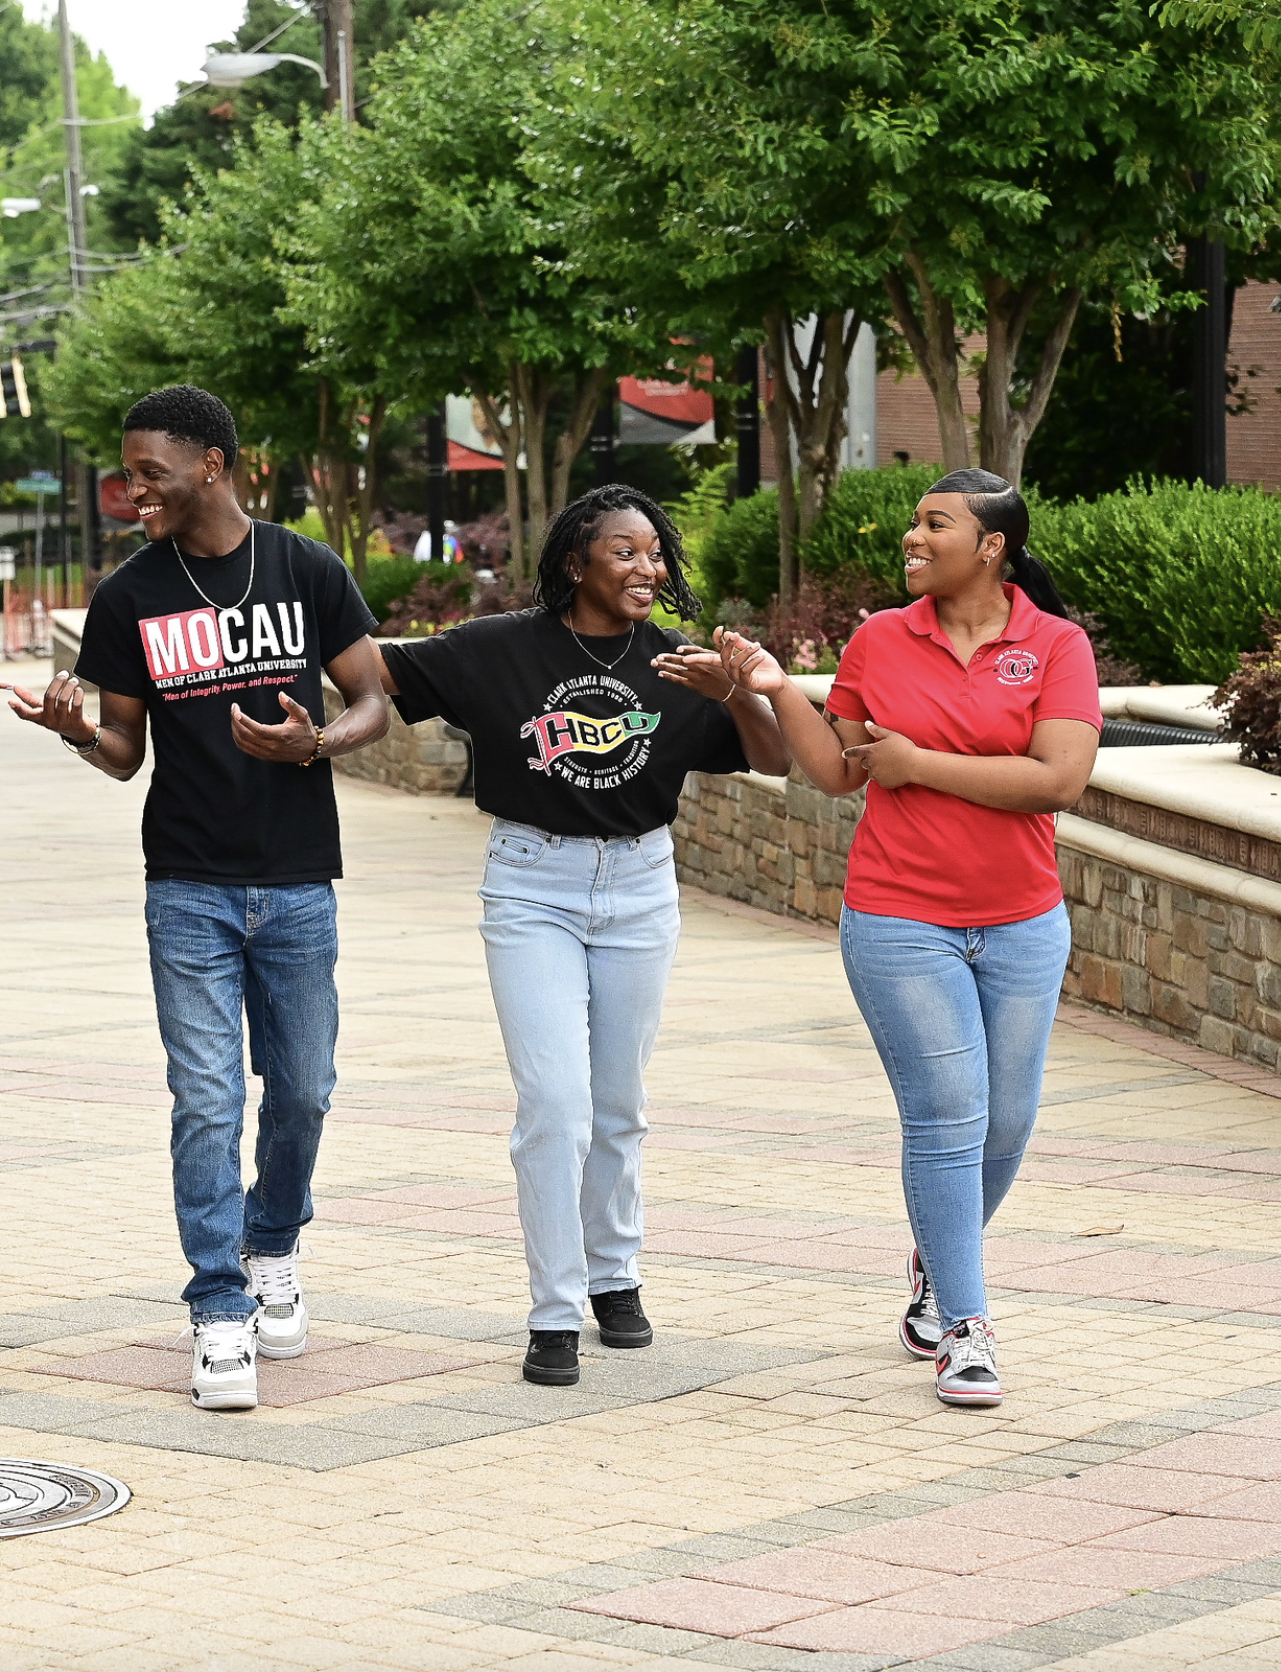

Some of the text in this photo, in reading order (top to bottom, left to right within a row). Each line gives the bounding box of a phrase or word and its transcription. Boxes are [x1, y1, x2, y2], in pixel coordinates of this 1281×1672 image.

[145, 602, 305, 676] MOCAU
[155, 658, 307, 689] MEN OF CLARK ATLANTA UNIVERSITY
[181, 690, 189, 699] of
[248, 677, 262, 687] and
[547, 682, 568, 704] CLARK
[566, 675, 597, 689] ATLANTA
[562, 688, 604, 704] ESTABLISHED
[546, 715, 649, 750] HBCU
[561, 746, 650, 789] WE ARE BLACK HISTORY
